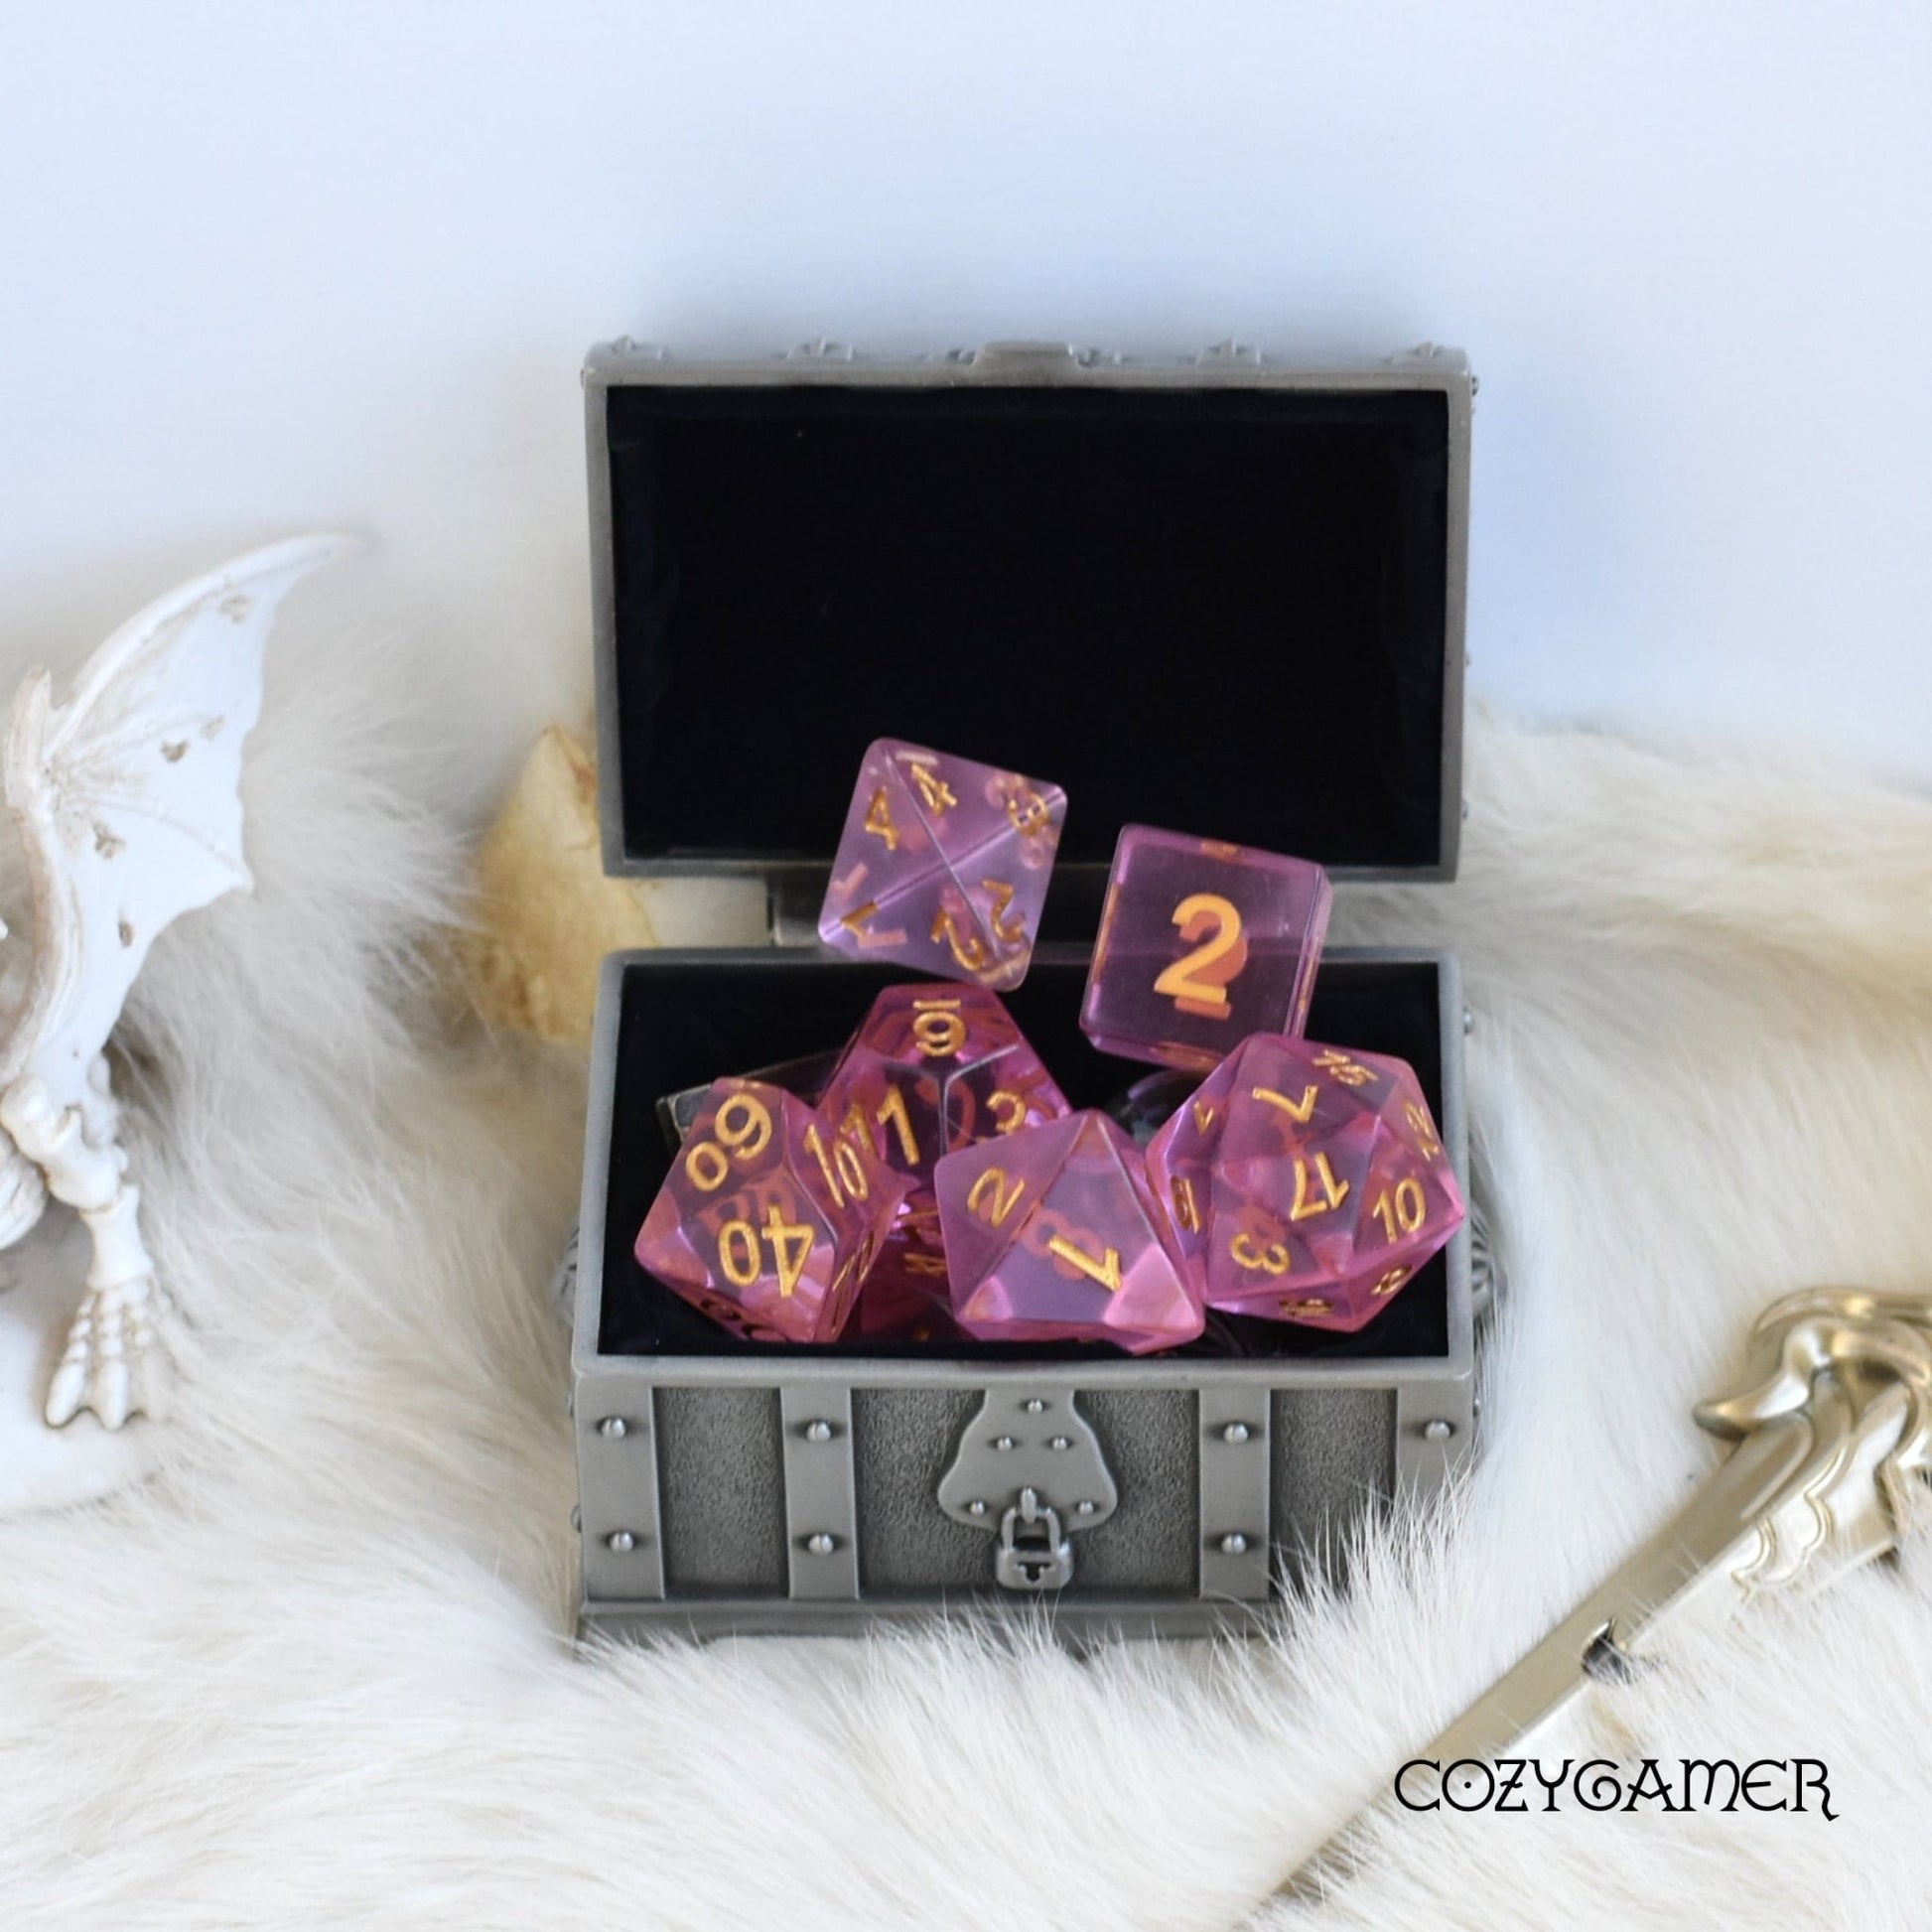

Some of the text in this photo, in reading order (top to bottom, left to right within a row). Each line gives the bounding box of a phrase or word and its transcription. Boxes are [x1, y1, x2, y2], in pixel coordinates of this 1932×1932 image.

[1153, 893, 1241, 1005] 2
[805, 1124, 869, 1209] 10
[966, 1167, 1026, 1229] 2
[1290, 1151, 1350, 1221] 17
[1373, 1176, 1427, 1244] 10
[718, 1204, 815, 1299] 40
[1230, 1233, 1290, 1276] 3
